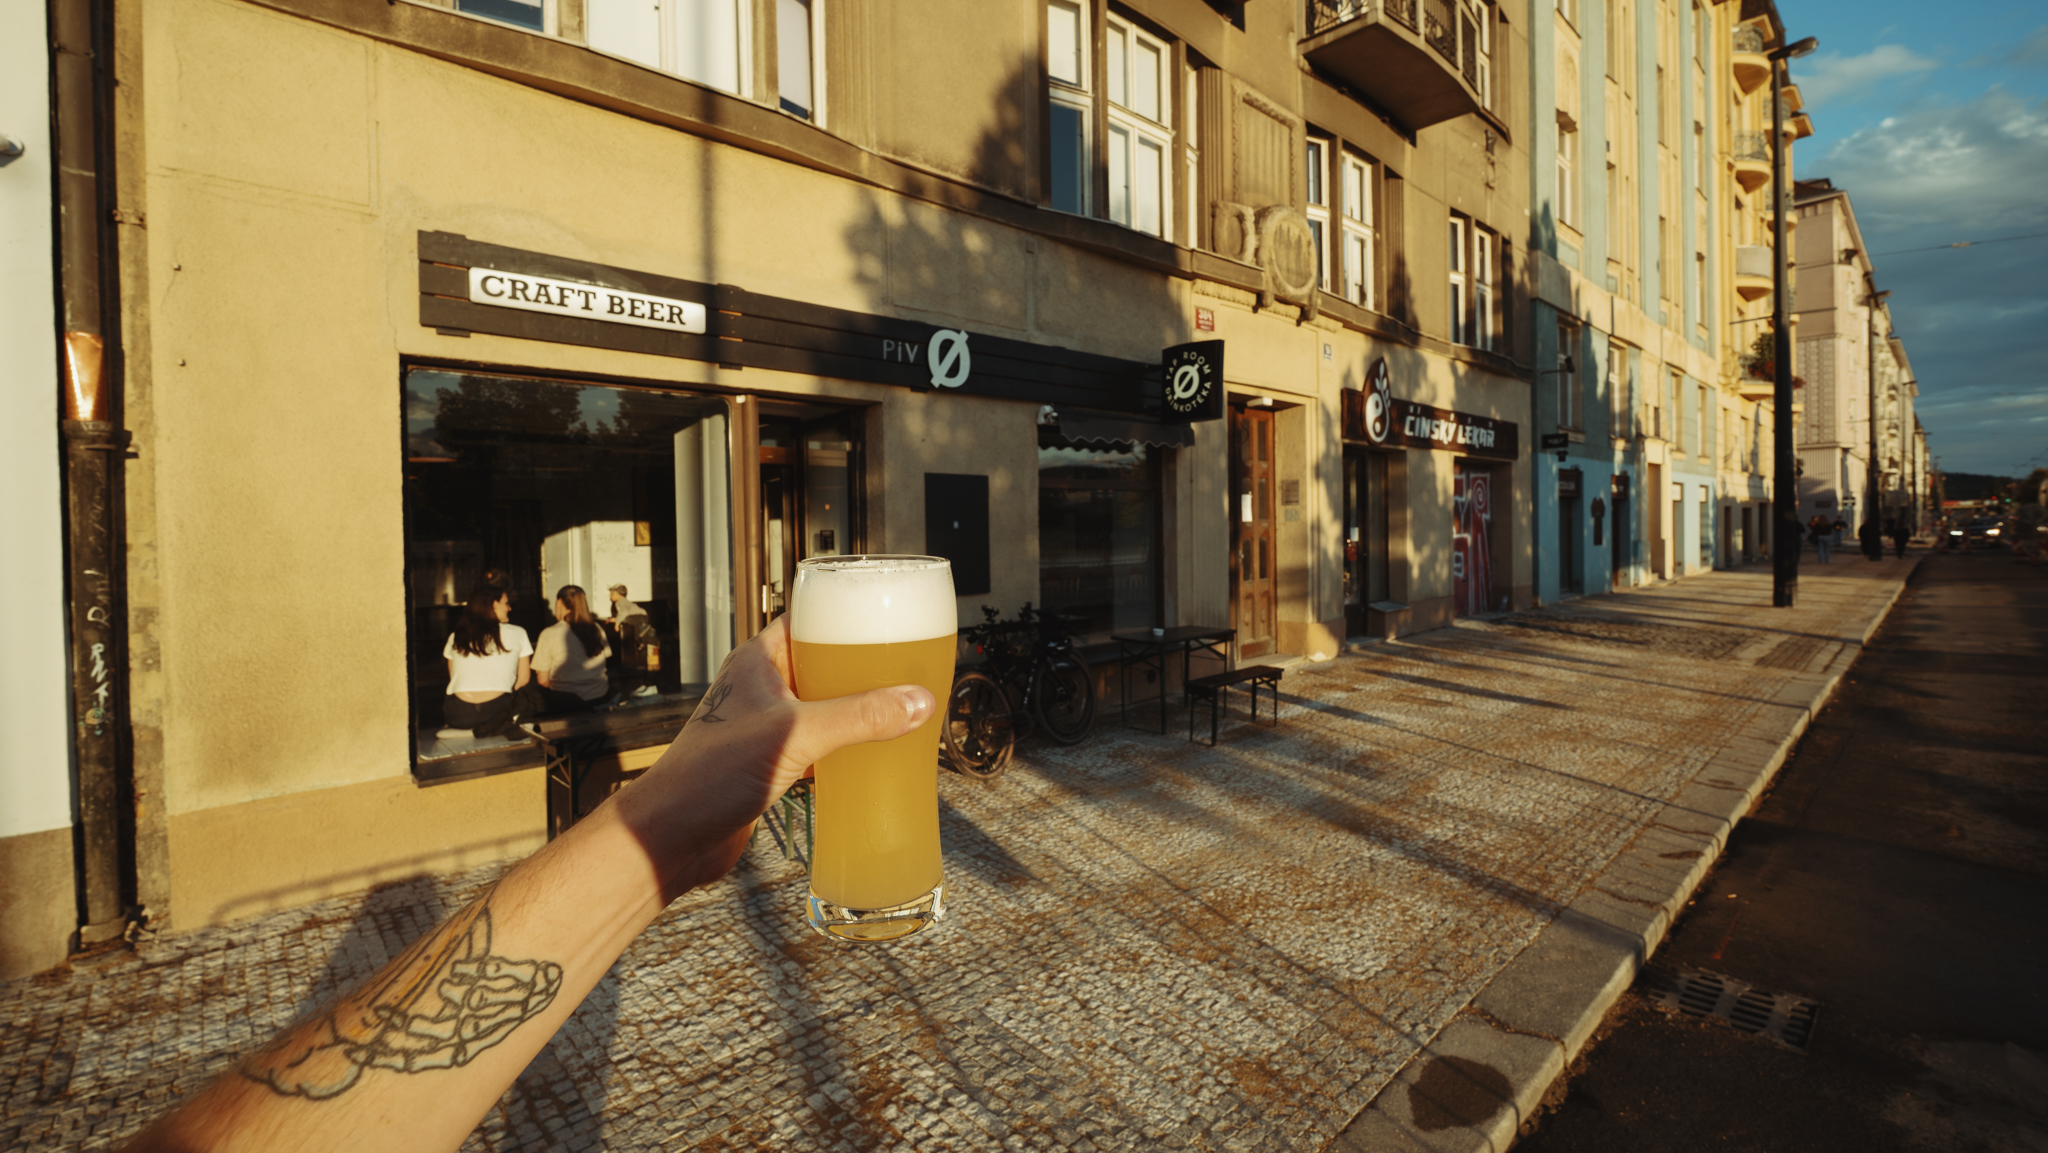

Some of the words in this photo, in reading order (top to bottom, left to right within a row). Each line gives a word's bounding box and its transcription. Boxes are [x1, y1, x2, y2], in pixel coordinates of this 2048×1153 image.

[480, 275, 597, 311] CRAFT
[606, 294, 686, 325] BEER
[1166, 358, 1178, 380] TAP
[1183, 351, 1211, 374] ROOM
